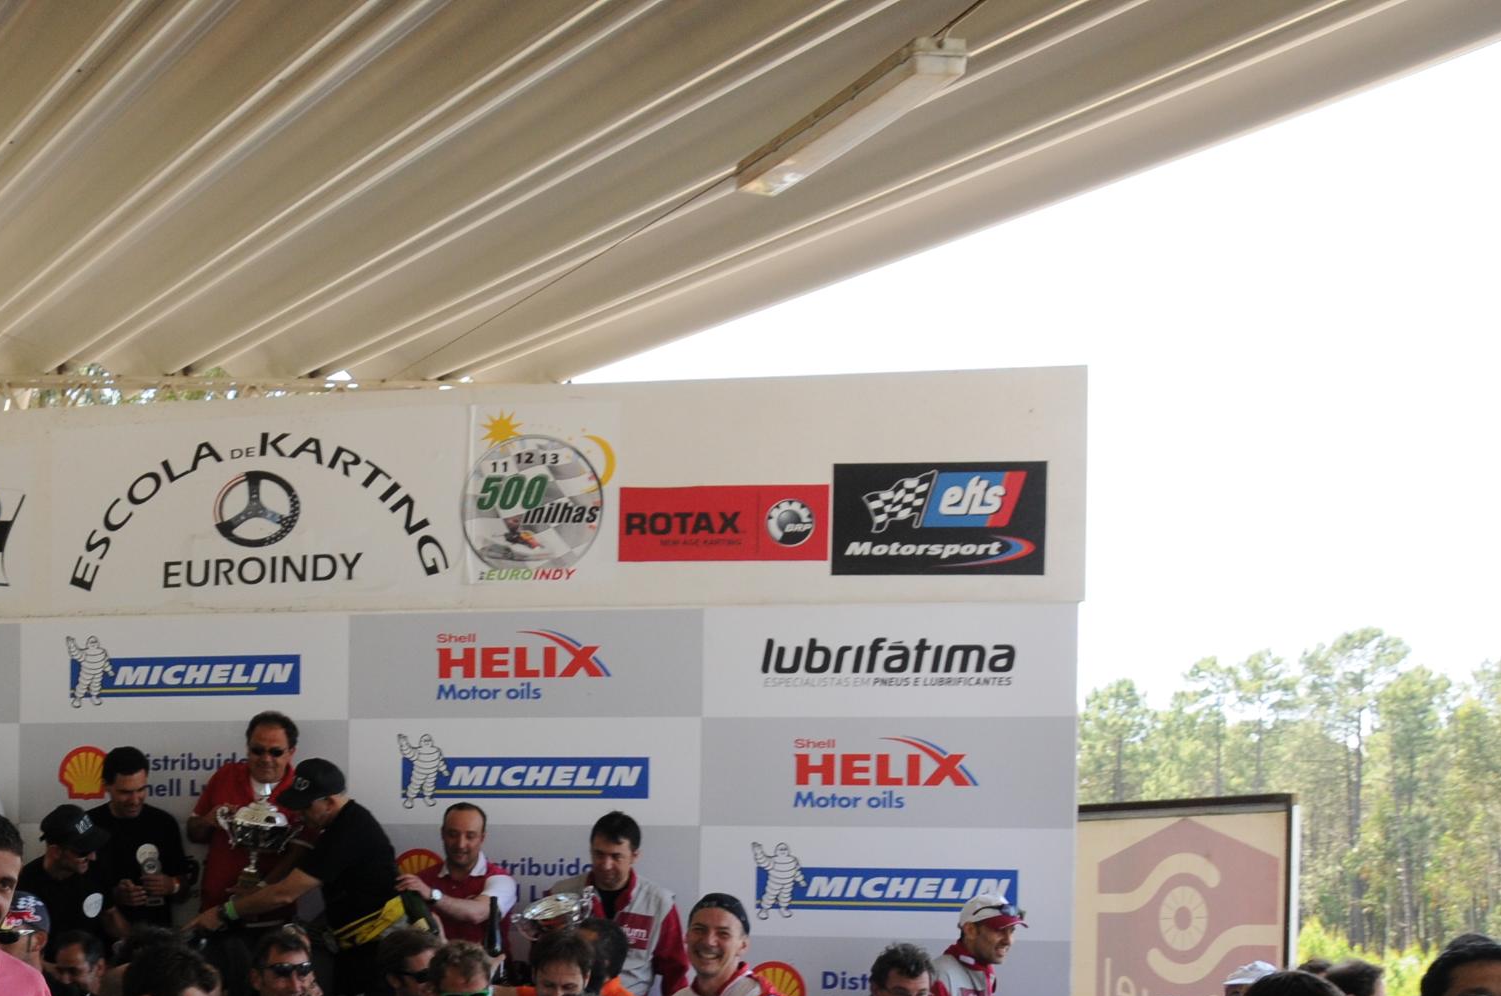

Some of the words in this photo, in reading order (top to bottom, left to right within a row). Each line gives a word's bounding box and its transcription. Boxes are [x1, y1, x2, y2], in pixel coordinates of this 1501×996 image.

[491, 461, 508, 473] 11
[515, 452, 534, 464] 12
[540, 453, 559, 465] 13
[477, 473, 549, 511] 500
[70, 440, 224, 592] ESCOLA
[229, 446, 255, 460] DE
[259, 431, 449, 577] KARTING
[522, 501, 599, 524] milhas
[625, 511, 741, 536] ROTAX
[784, 522, 813, 533] BRP
[844, 540, 1003, 559] Motorsport
[163, 552, 363, 588] EUROINDY
[485, 568, 577, 581] EUROINDY
[436, 632, 476, 644] Shell
[436, 645, 603, 679] HELIX
[761, 637, 1016, 676] lubrifátima
[111, 662, 293, 686] MICHELIN
[872, 677, 910, 687] PNEUS
[913, 677, 920, 687] E
[922, 676, 1013, 687] LUBRIFICANTES
[436, 683, 501, 700] Motor
[506, 682, 541, 700] oils
[794, 737, 836, 749] Shell
[449, 765, 642, 787] MICHELIN
[794, 753, 972, 787] HELIX
[794, 791, 862, 809] Motor
[868, 790, 905, 809] oils
[805, 876, 1011, 900] MICHELIN
